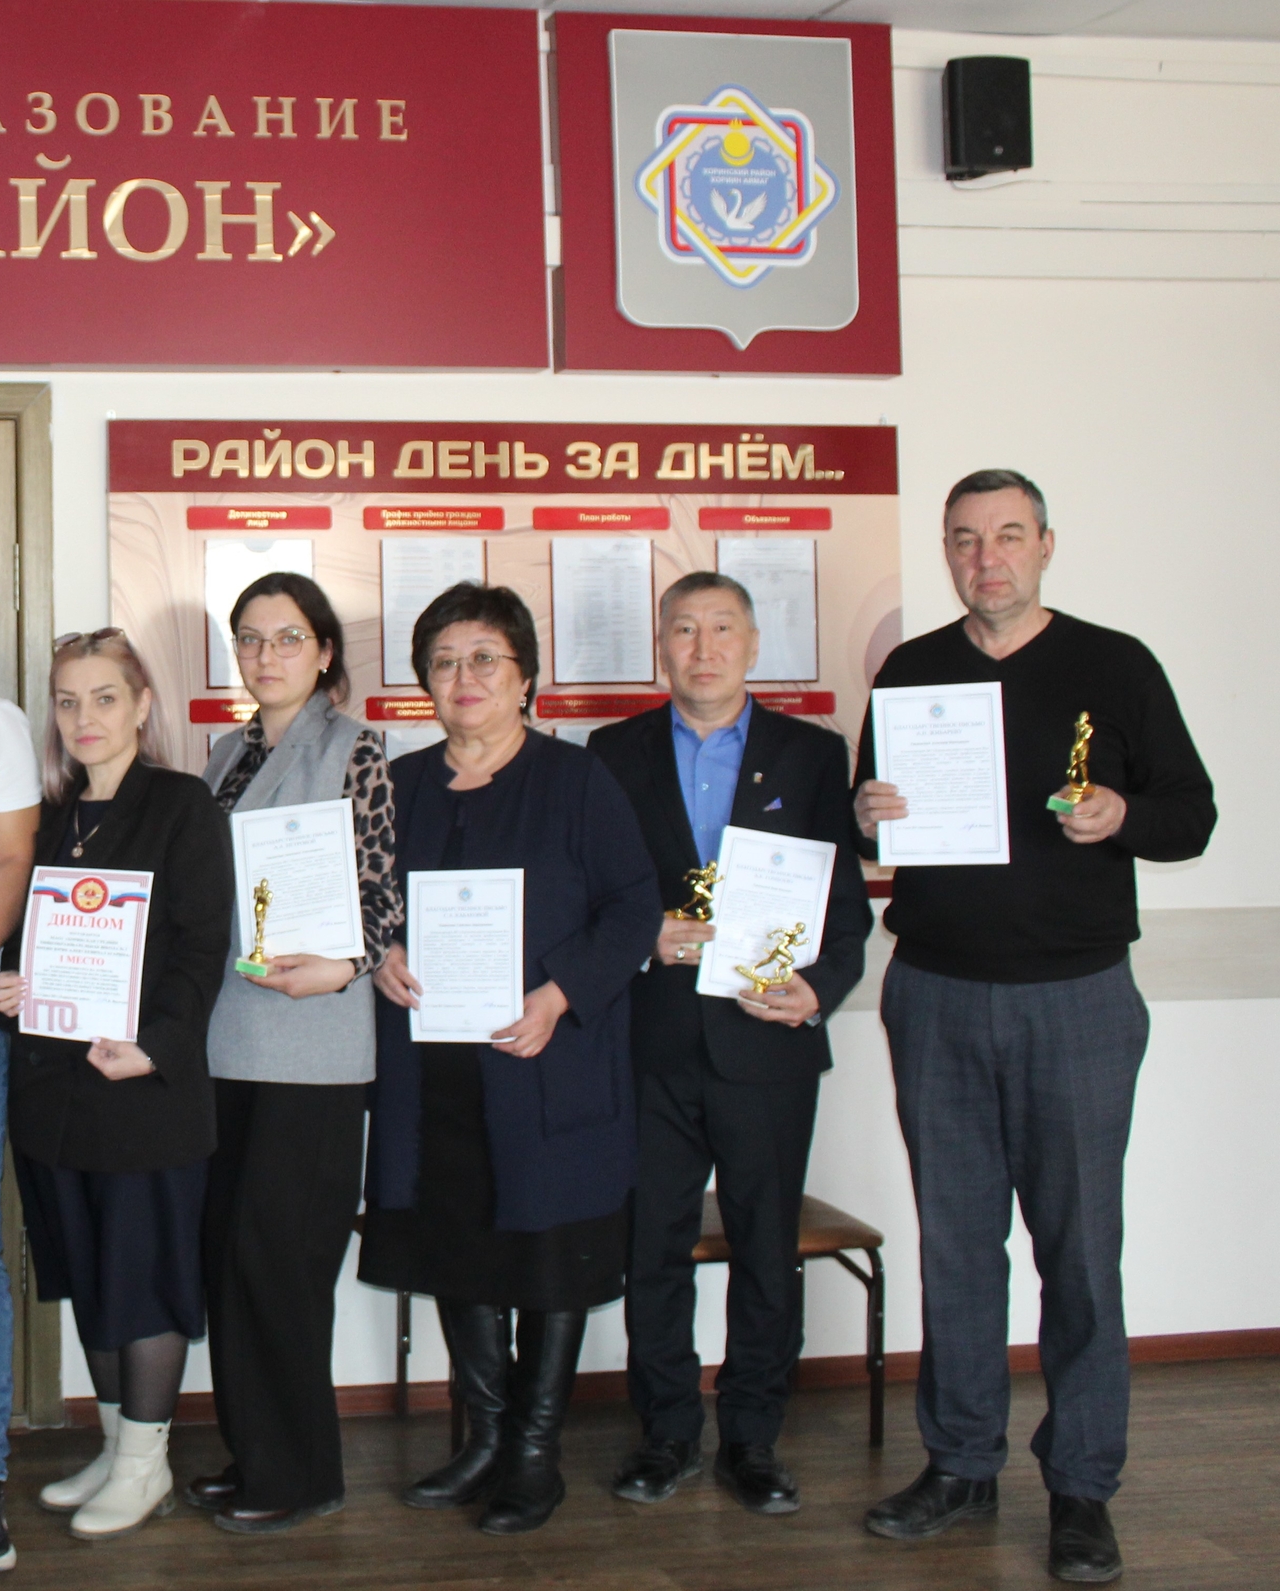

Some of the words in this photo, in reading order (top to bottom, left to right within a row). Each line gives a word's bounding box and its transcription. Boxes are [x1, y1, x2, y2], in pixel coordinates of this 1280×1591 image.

[172, 428, 375, 478] РАЙОН
[393, 440, 549, 479] ДЕНЬ
[565, 441, 639, 480] ЗА
[656, 433, 844, 480] ДНЁМ...
[227, 509, 287, 520] Должностные
[381, 509, 412, 520] График
[579, 513, 600, 522] План
[601, 513, 631, 522] работы
[744, 515, 791, 524] Объявления
[47, 913, 124, 931] ДИПЛОМ
[69, 955, 105, 967] МЕСТО
